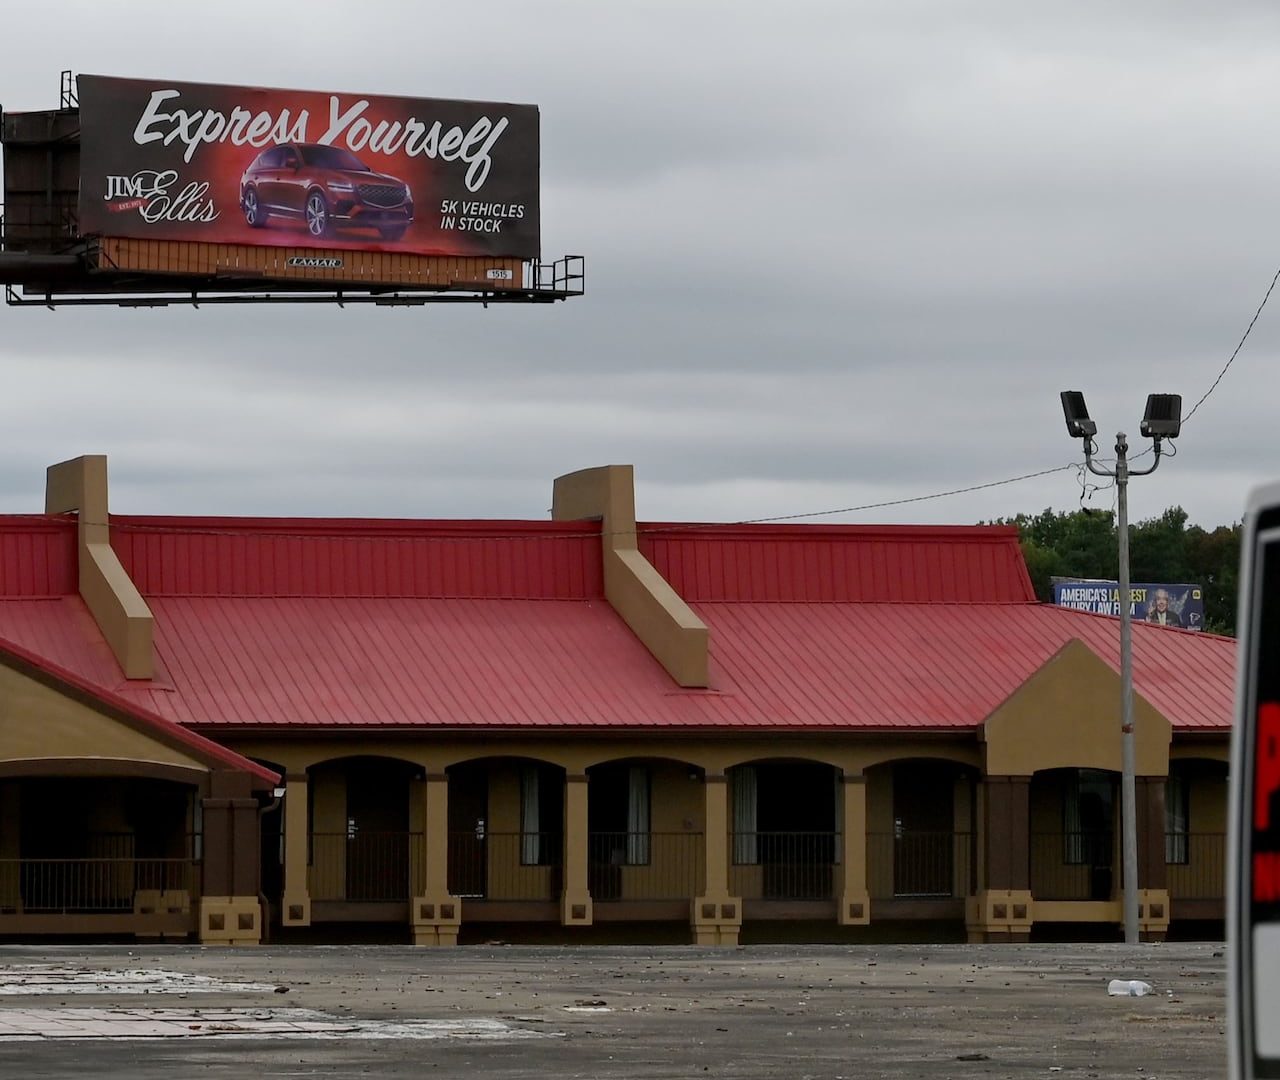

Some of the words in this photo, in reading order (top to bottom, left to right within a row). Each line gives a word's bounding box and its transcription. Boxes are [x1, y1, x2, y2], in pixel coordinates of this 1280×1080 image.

[133, 89, 309, 163] Express
[317, 95, 509, 192] Yourself
[104, 175, 143, 200] JIM
[131, 170, 221, 223] Ellis
[440, 200, 458, 214] 5K
[462, 201, 525, 218] VEHICLES
[440, 216, 456, 230] IN
[458, 217, 502, 232] STOCK
[293, 258, 337, 267] LAMAR
[492, 270, 508, 279] 1515
[1061, 588, 1108, 602] AMERICA'S
[1109, 588, 1147, 602] LAEST
[1114, 602, 1136, 615] FIM
